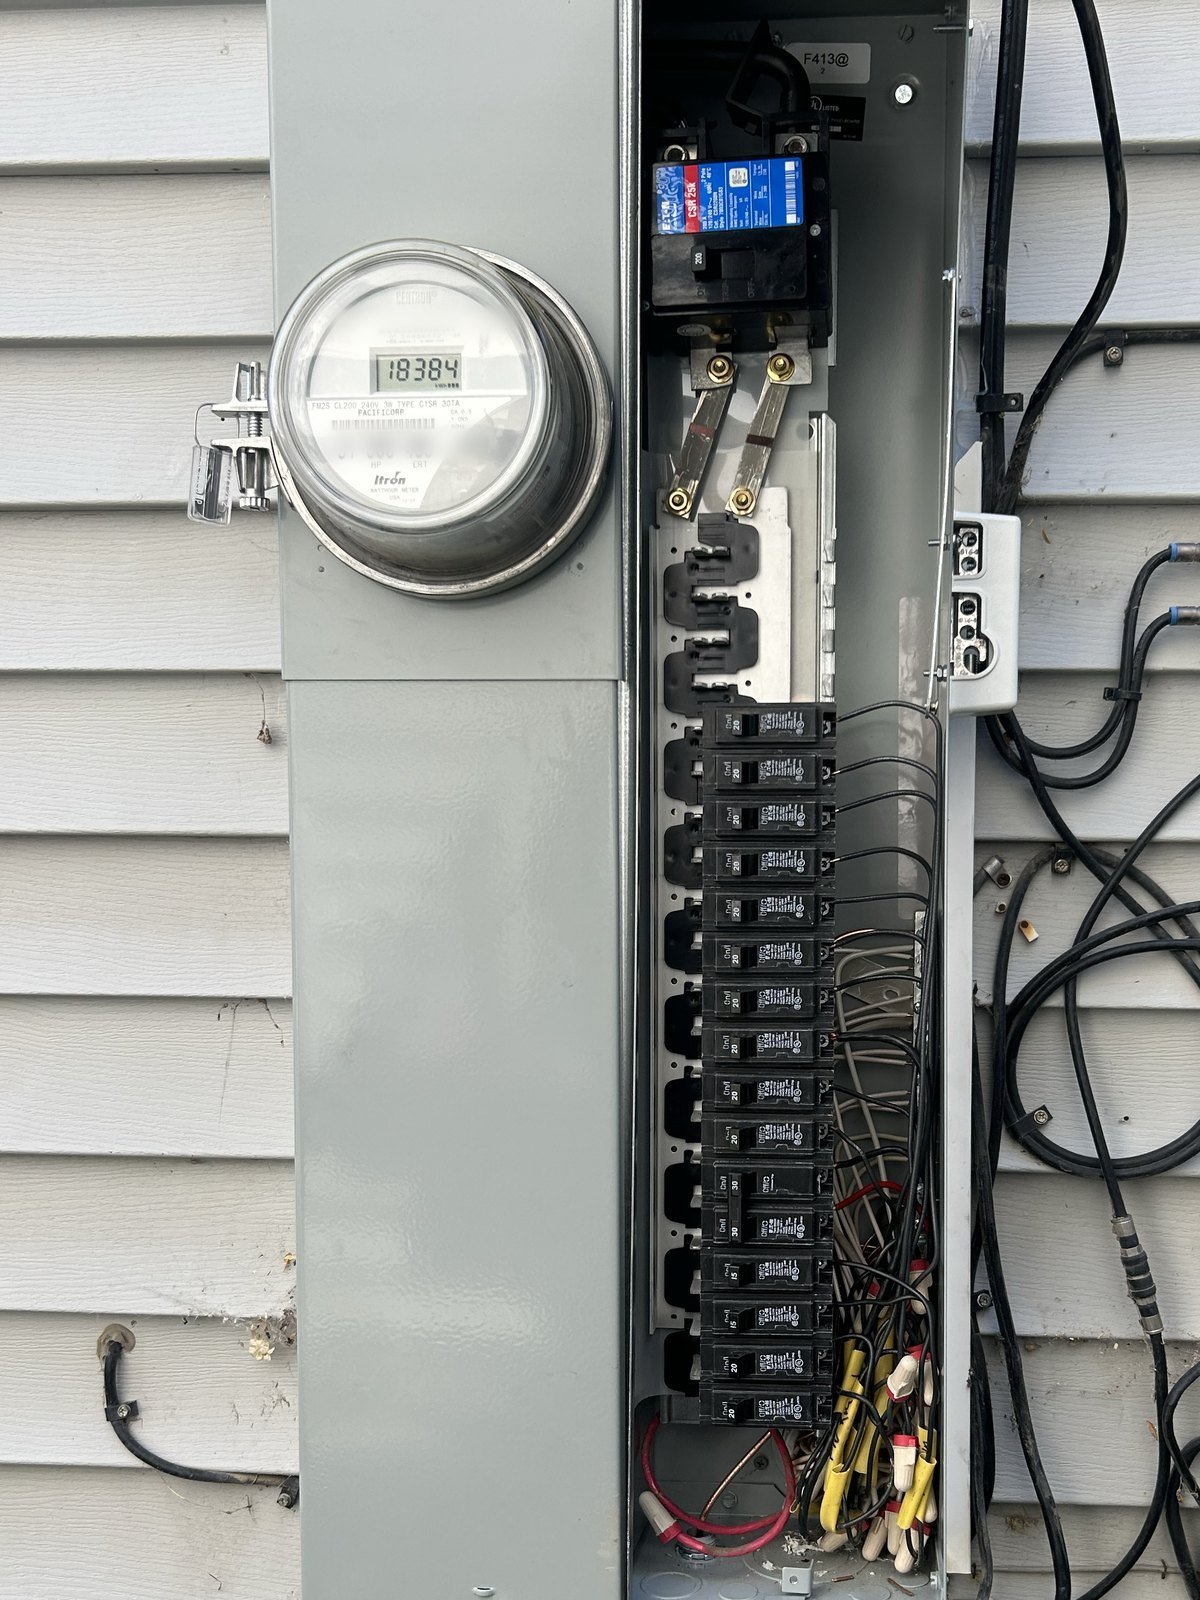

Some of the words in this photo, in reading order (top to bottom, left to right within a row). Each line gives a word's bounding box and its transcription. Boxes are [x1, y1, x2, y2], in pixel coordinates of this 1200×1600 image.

[804, 53, 850, 67] F413@
[688, 200, 697, 218] CSR
[695, 252, 704, 265] 200
[389, 358, 459, 381] 18384
[334, 401, 357, 409] CL200
[397, 400, 415, 408] TYPE
[374, 471, 406, 485] Itron
[733, 721, 740, 730] 20
[733, 769, 740, 778] 20
[733, 815, 739, 824] 20
[733, 862, 740, 871] 20
[733, 907, 739, 917] 20
[733, 954, 739, 964] 20
[732, 998, 738, 1008] 20
[732, 1044, 738, 1054] 20
[732, 1091, 738, 1101] 20
[732, 1135, 738, 1144] 20
[732, 1181, 738, 1190] 30
[732, 1227, 738, 1237] 30
[731, 1272, 737, 1280] 15
[731, 1363, 737, 1372] 20
[728, 1409, 735, 1418] 20
